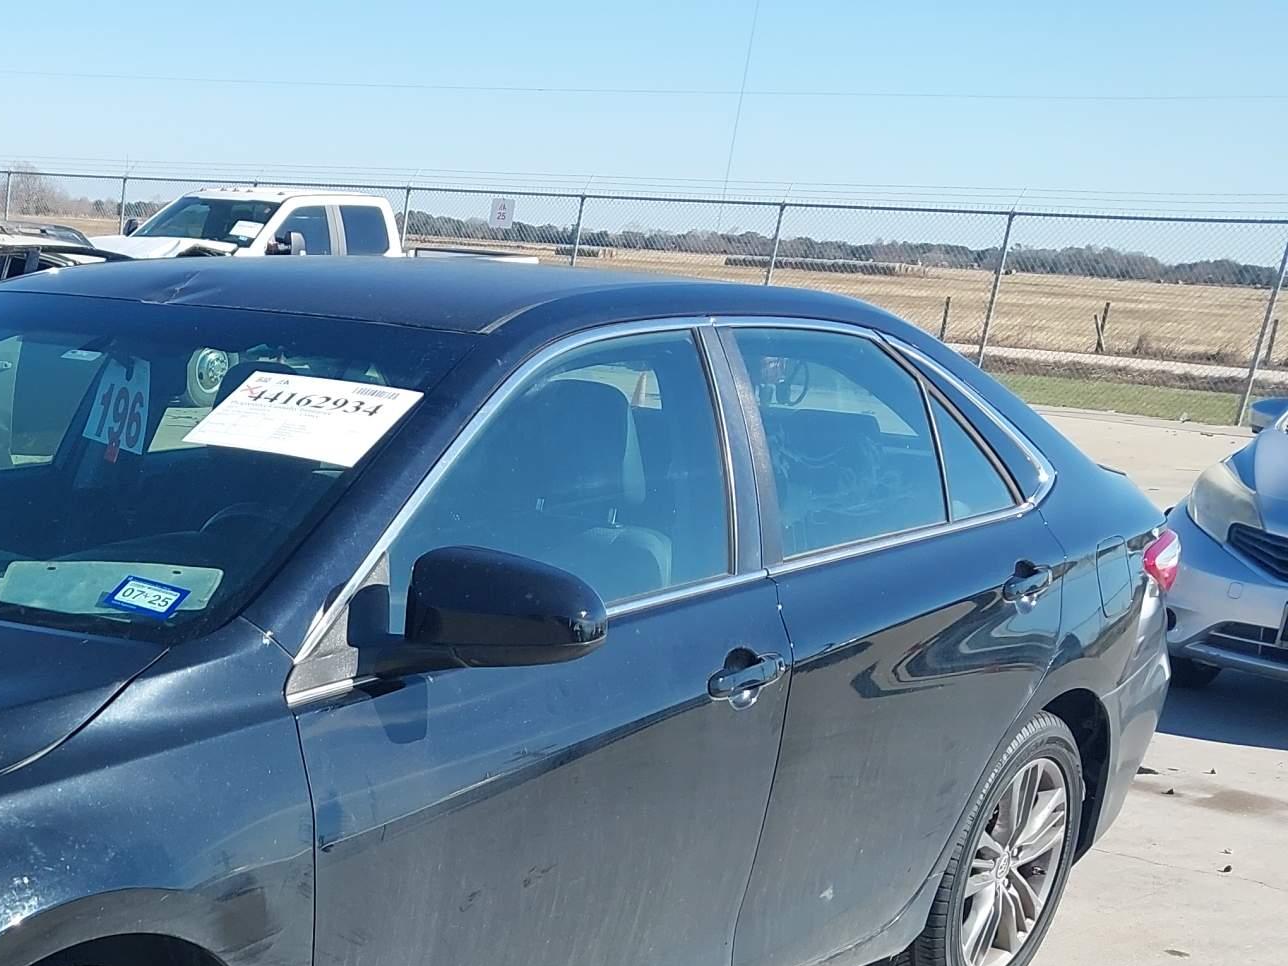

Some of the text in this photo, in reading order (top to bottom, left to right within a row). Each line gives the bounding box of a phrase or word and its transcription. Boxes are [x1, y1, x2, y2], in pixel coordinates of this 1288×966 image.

[496, 211, 506, 220] 25
[246, 389, 384, 417] 44162934
[95, 383, 144, 448] 196
[122, 587, 173, 608] 07 25
